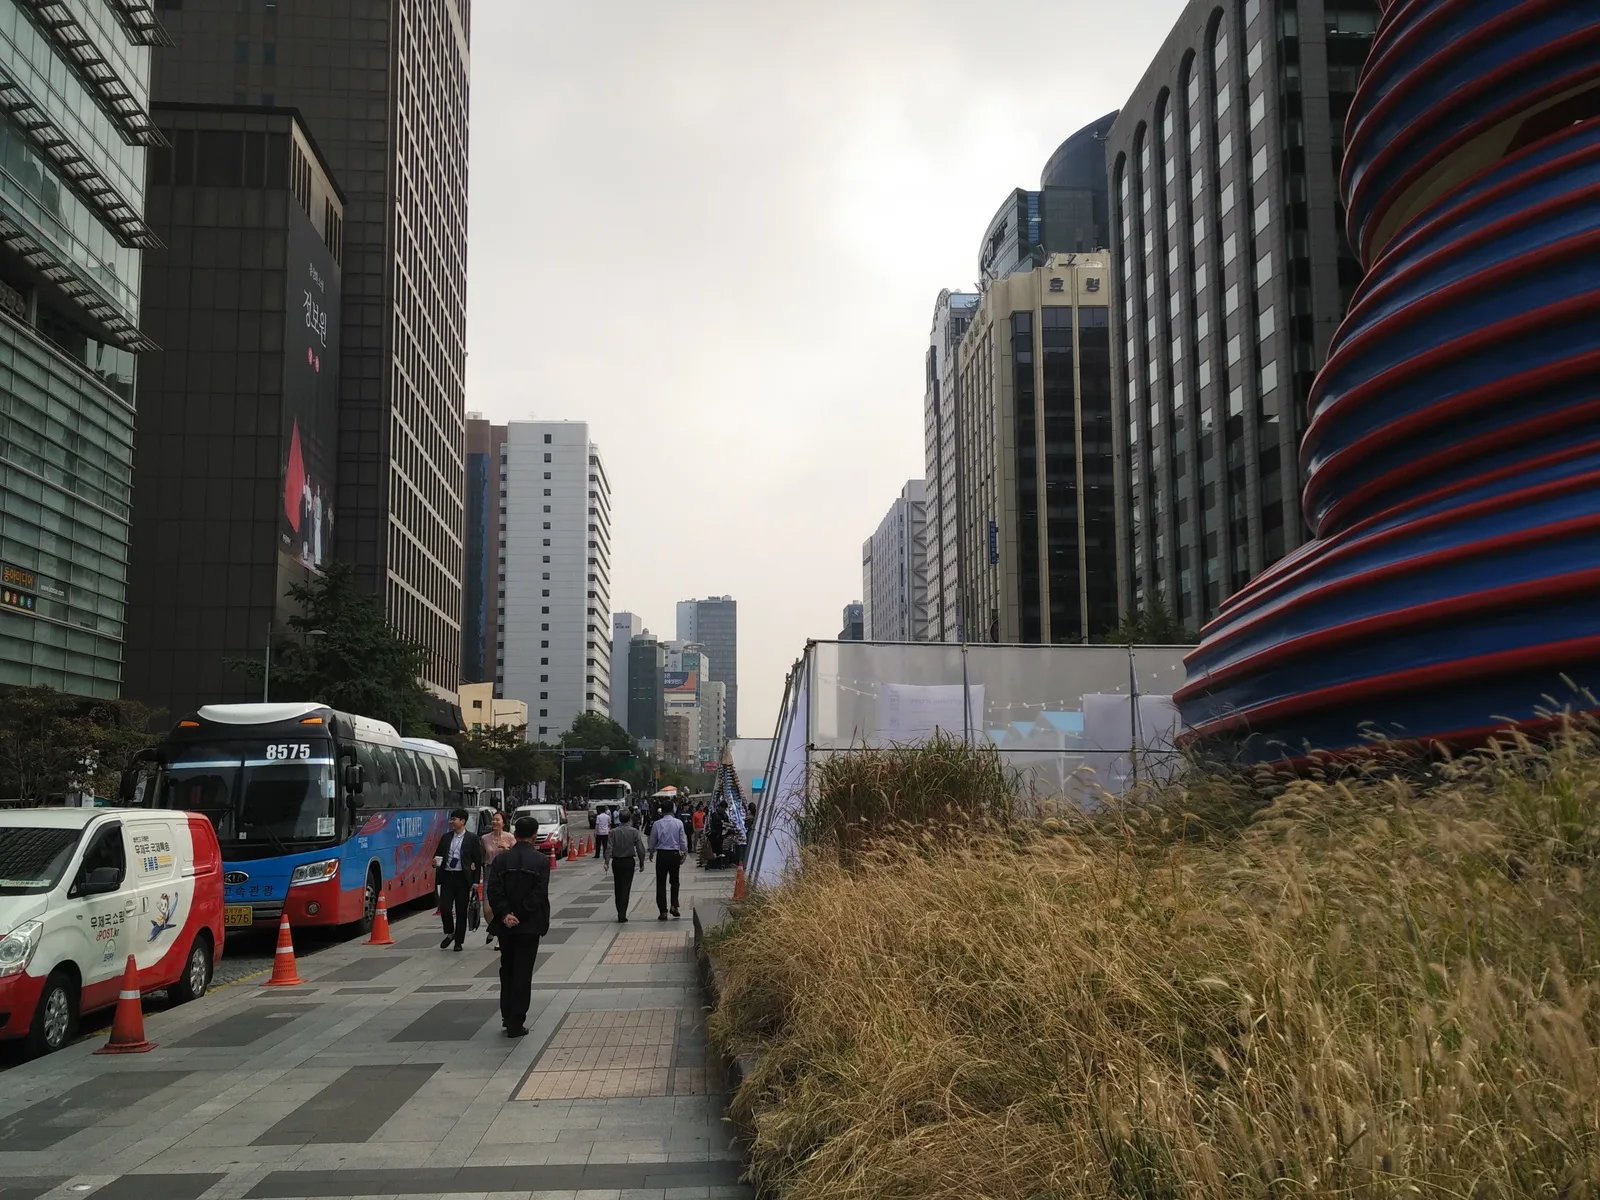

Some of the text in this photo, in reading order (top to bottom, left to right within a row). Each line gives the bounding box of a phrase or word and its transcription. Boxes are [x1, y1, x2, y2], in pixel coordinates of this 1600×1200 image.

[266, 744, 311, 760] 8575
[225, 874, 244, 883] KIA
[224, 914, 250, 924] 8575
